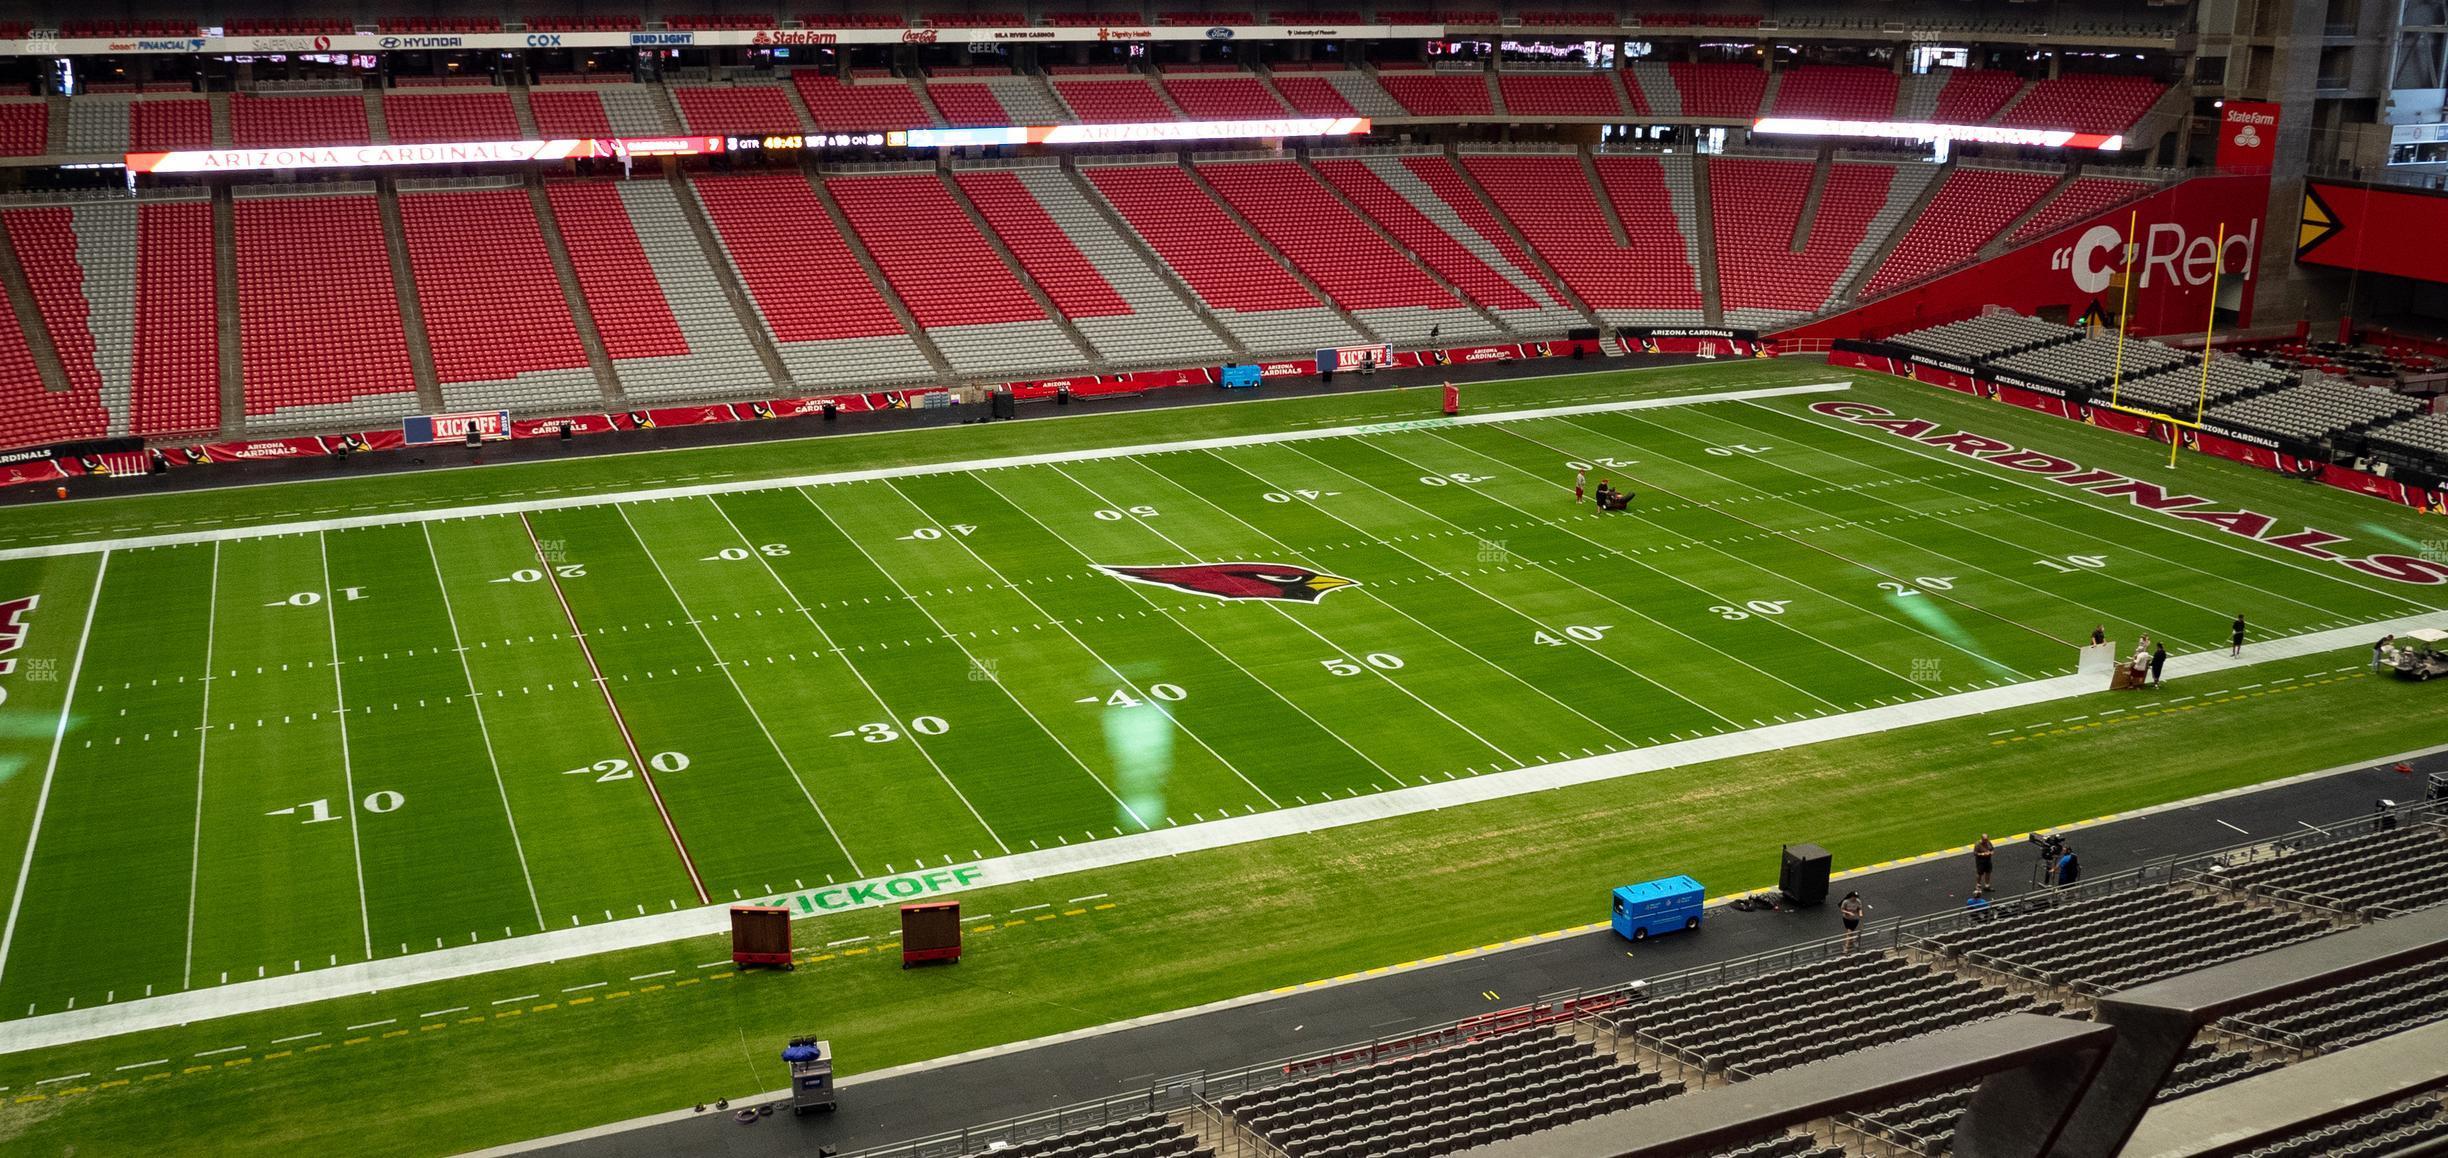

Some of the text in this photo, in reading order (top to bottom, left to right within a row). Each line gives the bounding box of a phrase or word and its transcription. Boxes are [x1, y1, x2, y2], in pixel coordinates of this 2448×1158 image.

[527, 34, 561, 46] COX
[632, 34, 692, 45] BUD LIGHT
[1112, 30, 1152, 39] Dignity Health
[138, 40, 185, 50] FINANCIAL
[403, 37, 462, 48] HYUNDAI
[1082, 125, 1181, 139] ARIZONA
[740, 140, 760, 149] QTR
[852, 137, 867, 146] ON
[204, 140, 524, 167] ARIZONA CARDINALS
[2140, 218, 2258, 289] Red
[1688, 329, 1734, 337] CARDINALS
[1340, 349, 1383, 366] KICKFF
[1911, 354, 1975, 375] ARIZONA CARDINALS
[1042, 380, 1072, 388] ARIZONA
[1995, 374, 2066, 397] ARIZONA CARDINALS
[795, 403, 846, 413] CARDILS
[531, 423, 588, 434] CARDIALS
[247, 442, 285, 451] ARIZONA
[2231, 431, 2280, 449] CARDINALS
[0, 449, 51, 464] RDINALS
[236, 446, 297, 458] CARDINALS
[1809, 401, 2448, 585] CARDINALS
[1105, 682, 1188, 710] 40
[858, 715, 951, 744] 30
[595, 750, 691, 783] 20
[298, 790, 406, 824] 10
